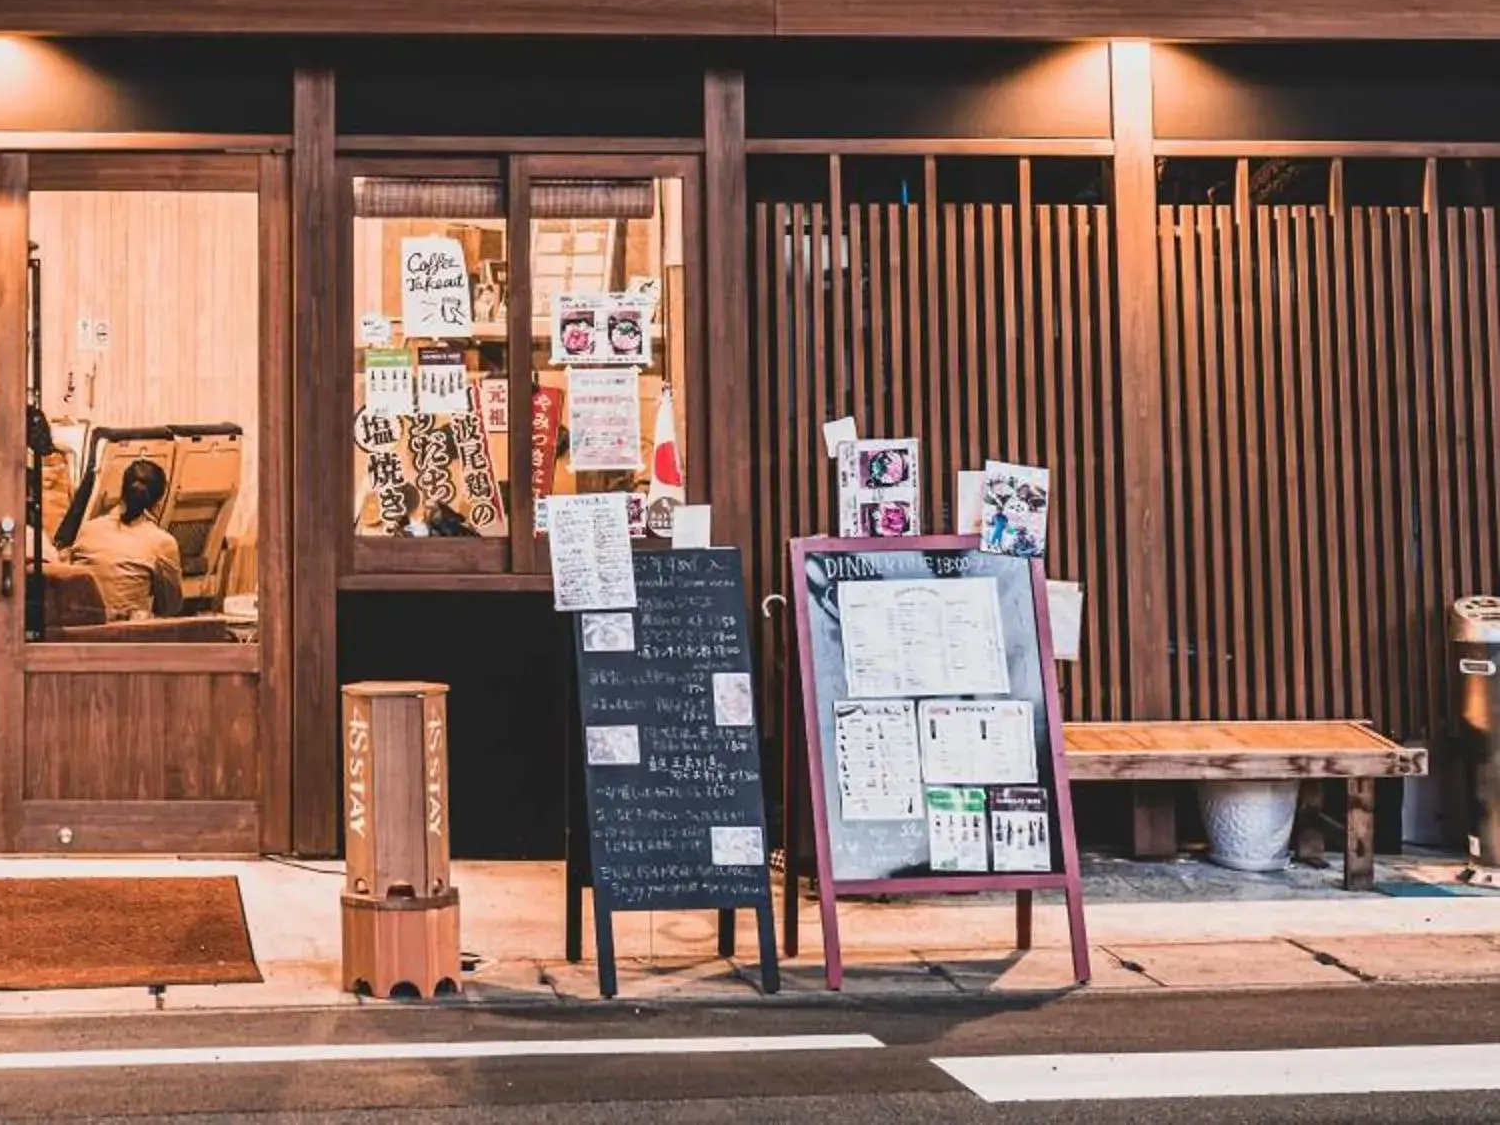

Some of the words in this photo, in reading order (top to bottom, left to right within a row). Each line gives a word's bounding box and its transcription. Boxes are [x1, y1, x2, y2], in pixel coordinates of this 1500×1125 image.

[406, 274, 465, 292] Takeout
[407, 252, 461, 276] Coffee
[487, 383, 507, 426] 元祖
[348, 756, 369, 840] STAY
[427, 757, 442, 838] STAY
